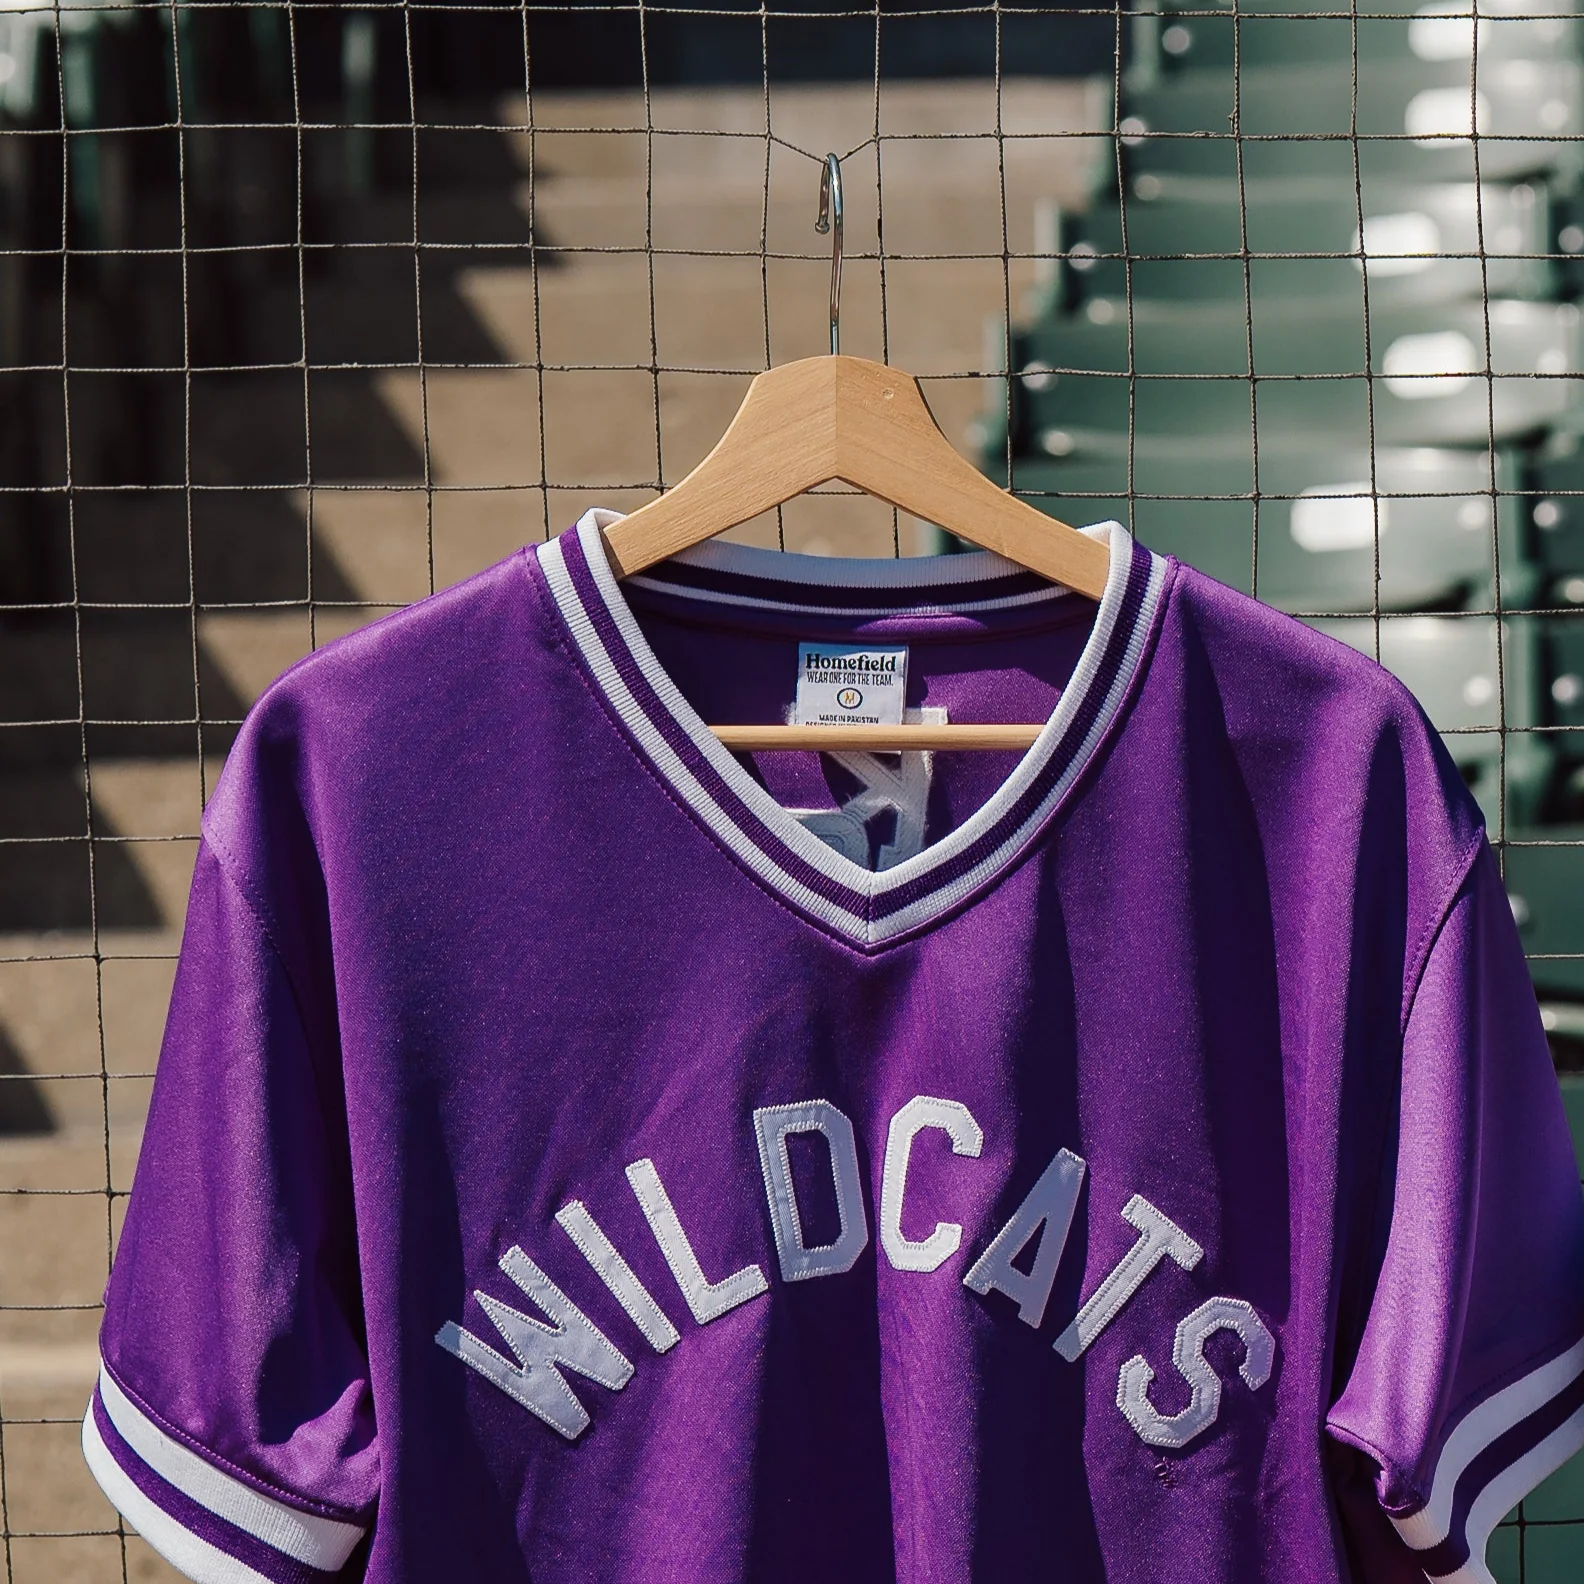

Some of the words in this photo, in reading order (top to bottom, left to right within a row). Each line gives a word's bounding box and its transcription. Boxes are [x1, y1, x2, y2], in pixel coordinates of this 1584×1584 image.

[805, 653, 897, 672] Homefield
[807, 671, 828, 683] WEAR
[829, 672, 842, 684] ONE
[843, 672, 857, 685] FOR
[857, 673, 870, 685] THE
[872, 674, 894, 686] TEAM.
[819, 714, 838, 722] MADE
[838, 715, 846, 723] IN
[847, 715, 879, 724] PAKISTAN
[434, 1094, 1277, 1449] WILDCATS
